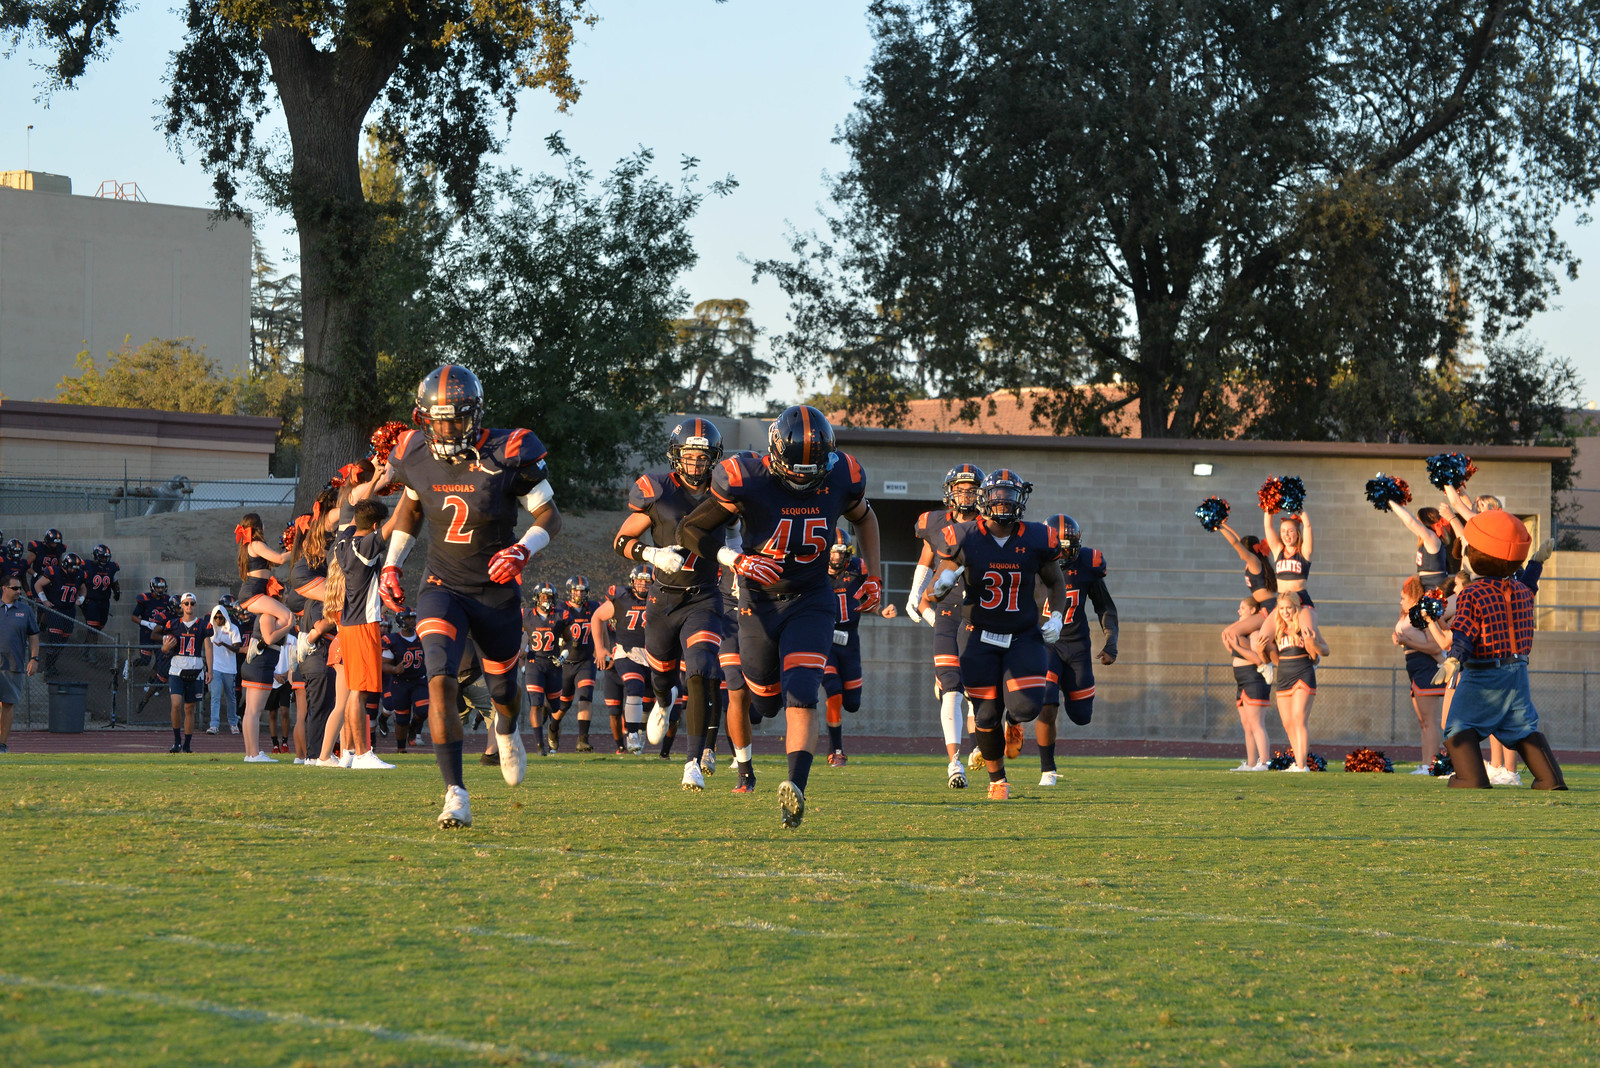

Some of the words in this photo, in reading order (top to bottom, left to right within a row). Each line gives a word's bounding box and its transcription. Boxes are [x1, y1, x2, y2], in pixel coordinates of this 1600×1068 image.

[432, 484, 476, 493] SEQUOIAS
[441, 495, 474, 544] 2
[781, 507, 820, 516] SEQUOIAS
[760, 517, 829, 564] 45
[989, 562, 1020, 570] SEQUOIAS
[1275, 559, 1302, 574] GIANTS
[93, 574, 111, 591] 99
[979, 571, 1022, 612] 31
[60, 585, 77, 603] 72
[531, 631, 555, 652] 32
[570, 623, 592, 645] 97
[178, 636, 196, 656] 14
[403, 650, 423, 669] 95
